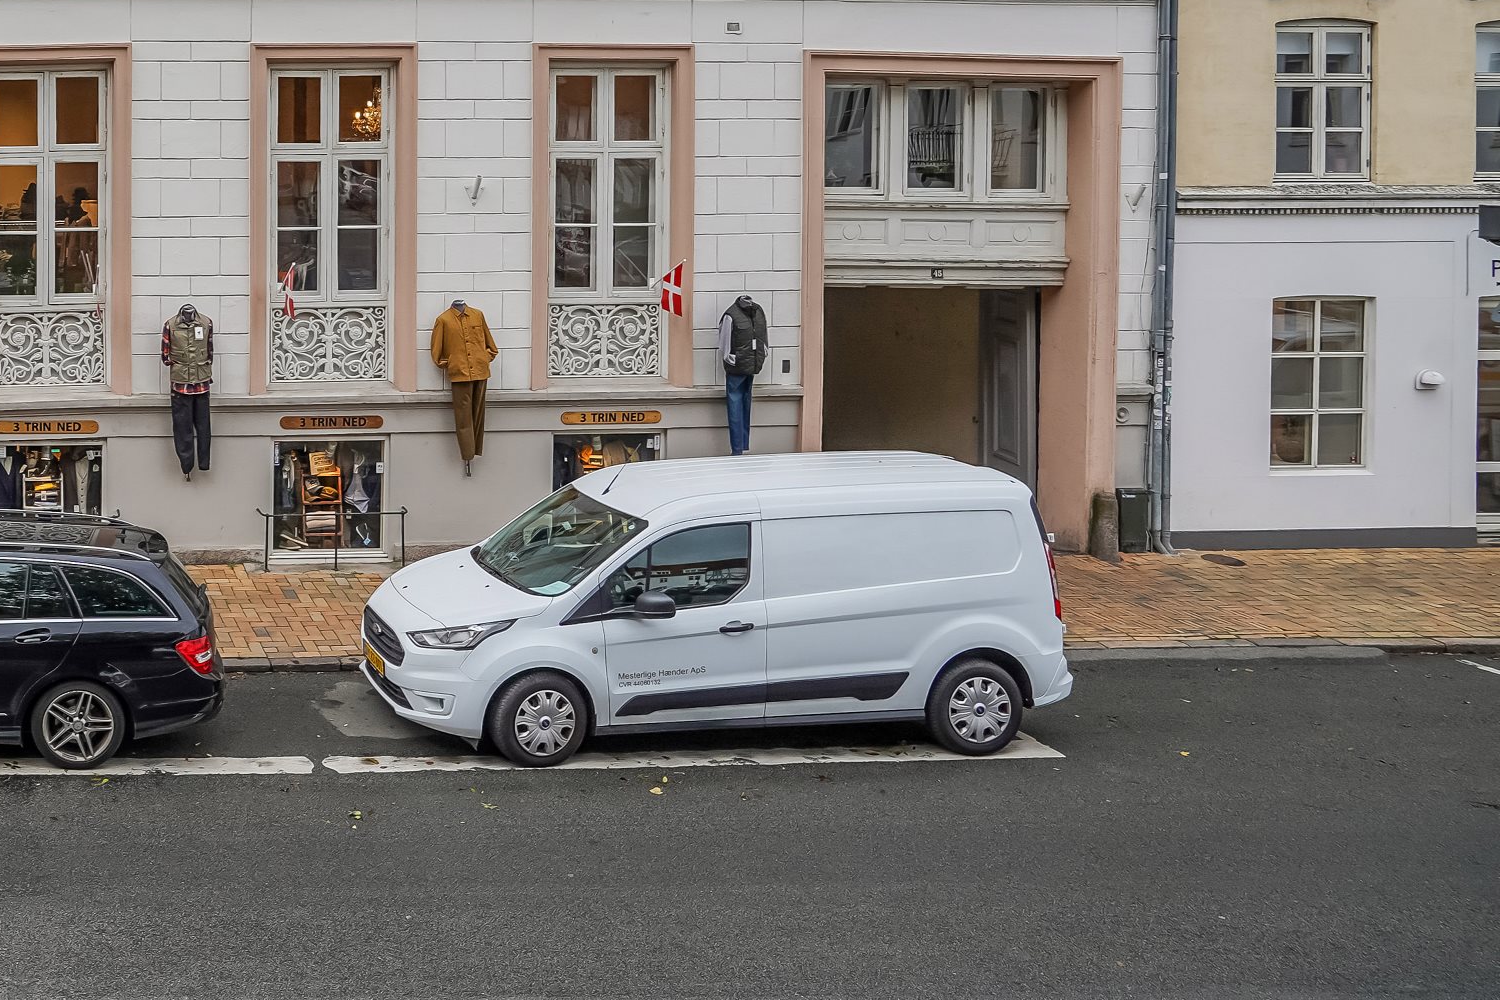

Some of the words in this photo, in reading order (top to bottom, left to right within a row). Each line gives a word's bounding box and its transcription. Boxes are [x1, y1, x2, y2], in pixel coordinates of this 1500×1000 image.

[300, 417, 306, 427] 3
[311, 417, 337, 427] TRIN
[342, 417, 367, 427] NED
[580, 413, 586, 422] 3
[591, 412, 616, 422] TRIN
[622, 412, 645, 422] NED
[13, 422, 20, 432] 3
[25, 422, 51, 432] TRIN
[57, 422, 81, 432] NED
[618, 671, 657, 680] Mesterlige
[658, 669, 689, 677] Hænder
[690, 665, 706, 674] ApS
